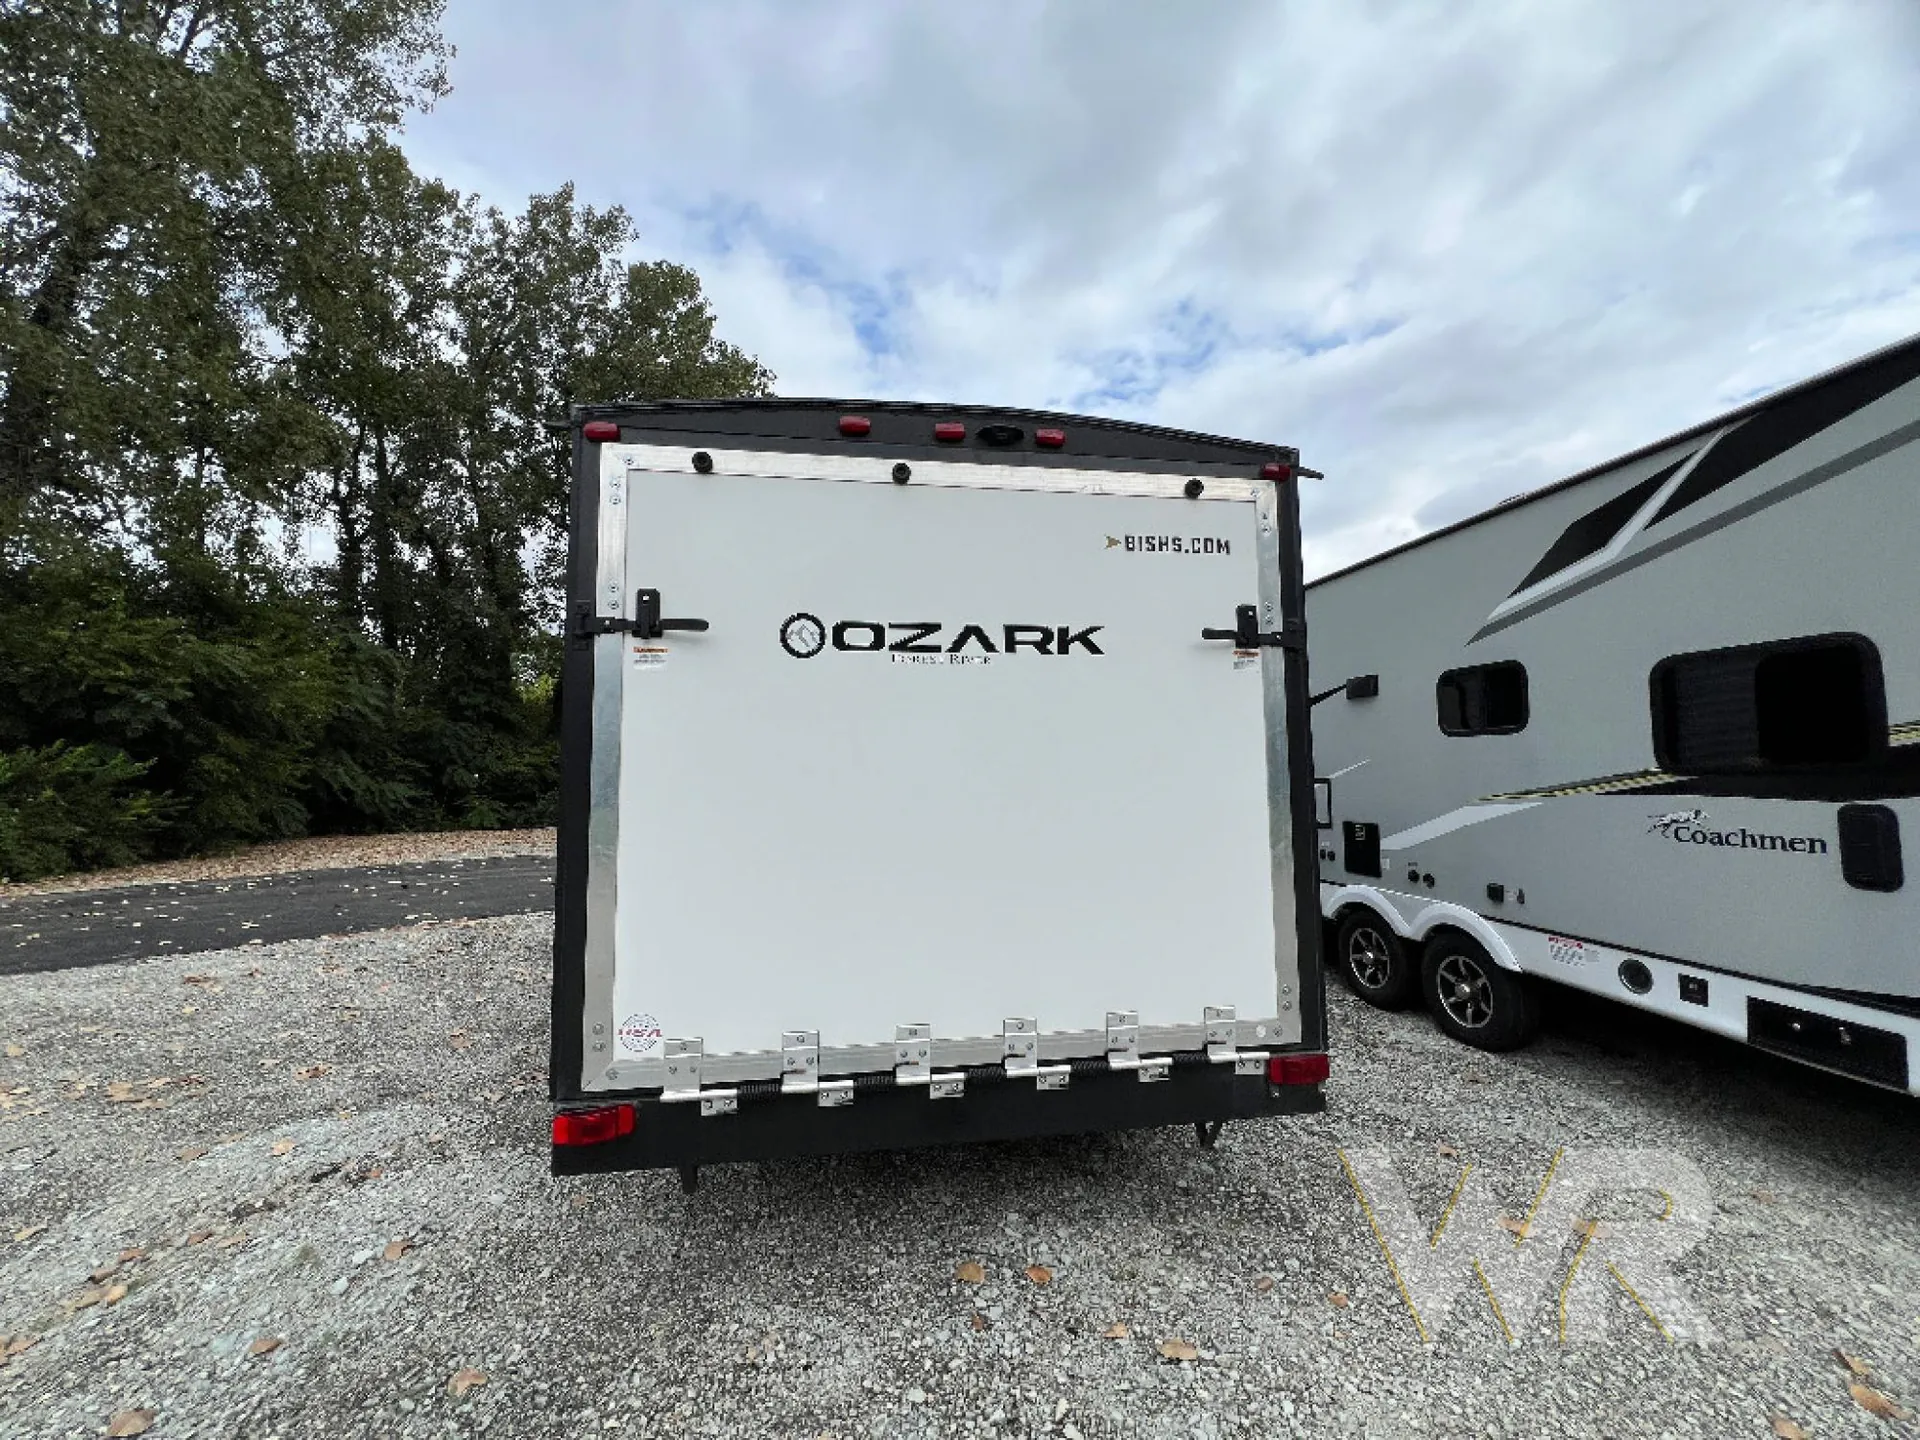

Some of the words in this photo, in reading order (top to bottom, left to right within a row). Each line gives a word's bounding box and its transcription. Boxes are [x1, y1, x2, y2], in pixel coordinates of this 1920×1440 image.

[1124, 534, 1230, 555] BISHS.COM
[831, 620, 1105, 656] OZARK
[1673, 826, 1827, 854] Coachmen
